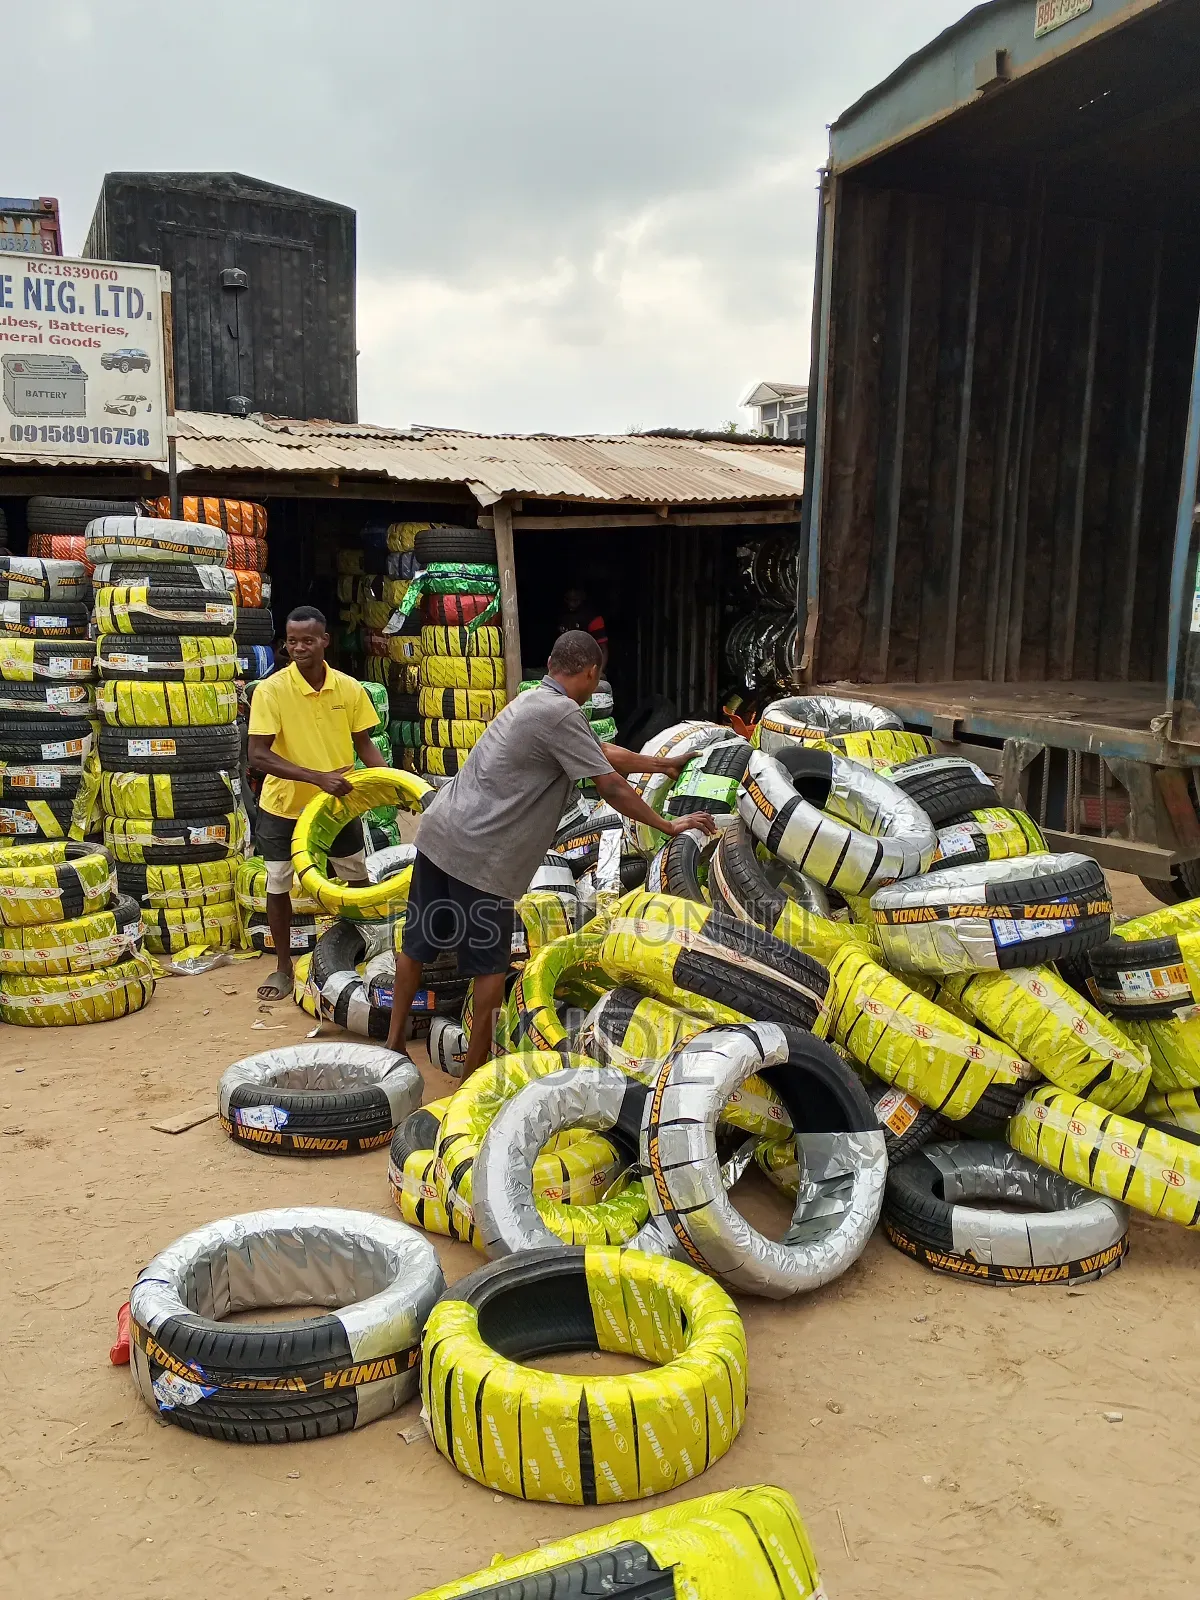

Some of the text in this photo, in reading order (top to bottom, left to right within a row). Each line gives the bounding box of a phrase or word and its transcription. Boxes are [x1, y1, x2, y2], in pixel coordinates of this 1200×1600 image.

[44, 240, 53, 253] 3
[27, 261, 118, 281] RC:1839060
[23, 276, 85, 315] NIG.
[94, 283, 152, 321] LTD.
[48, 319, 129, 338] Batteries,
[48, 334, 102, 349] Goods
[25, 389, 67, 400] BATTERY
[9, 424, 150, 447] 09158916758
[120, 536, 153, 547] WINDA
[157, 540, 189, 553] WINDA
[193, 546, 217, 556] WINDA
[5, 622, 37, 635] WINDA
[1023, 903, 1081, 919] WINDA
[237, 1125, 284, 1145] WINDA
[292, 1135, 349, 1151] WINDA
[358, 1128, 396, 1149] WIND
[925, 1249, 989, 1278] WINDA
[1002, 1265, 1070, 1282] WINDA
[1080, 1241, 1123, 1274] WINDA
[628, 1278, 649, 1317] MIRAGE
[603, 1308, 628, 1345] MIRAGE
[651, 1310, 671, 1351] MIRAGE
[323, 1357, 398, 1390] WINDA
[485, 1414, 507, 1460] MIRAGE
[542, 1426, 567, 1469] MIRAGE
[642, 1421, 665, 1459] MIRAGE
[598, 1460, 625, 1498] MIRAGE
